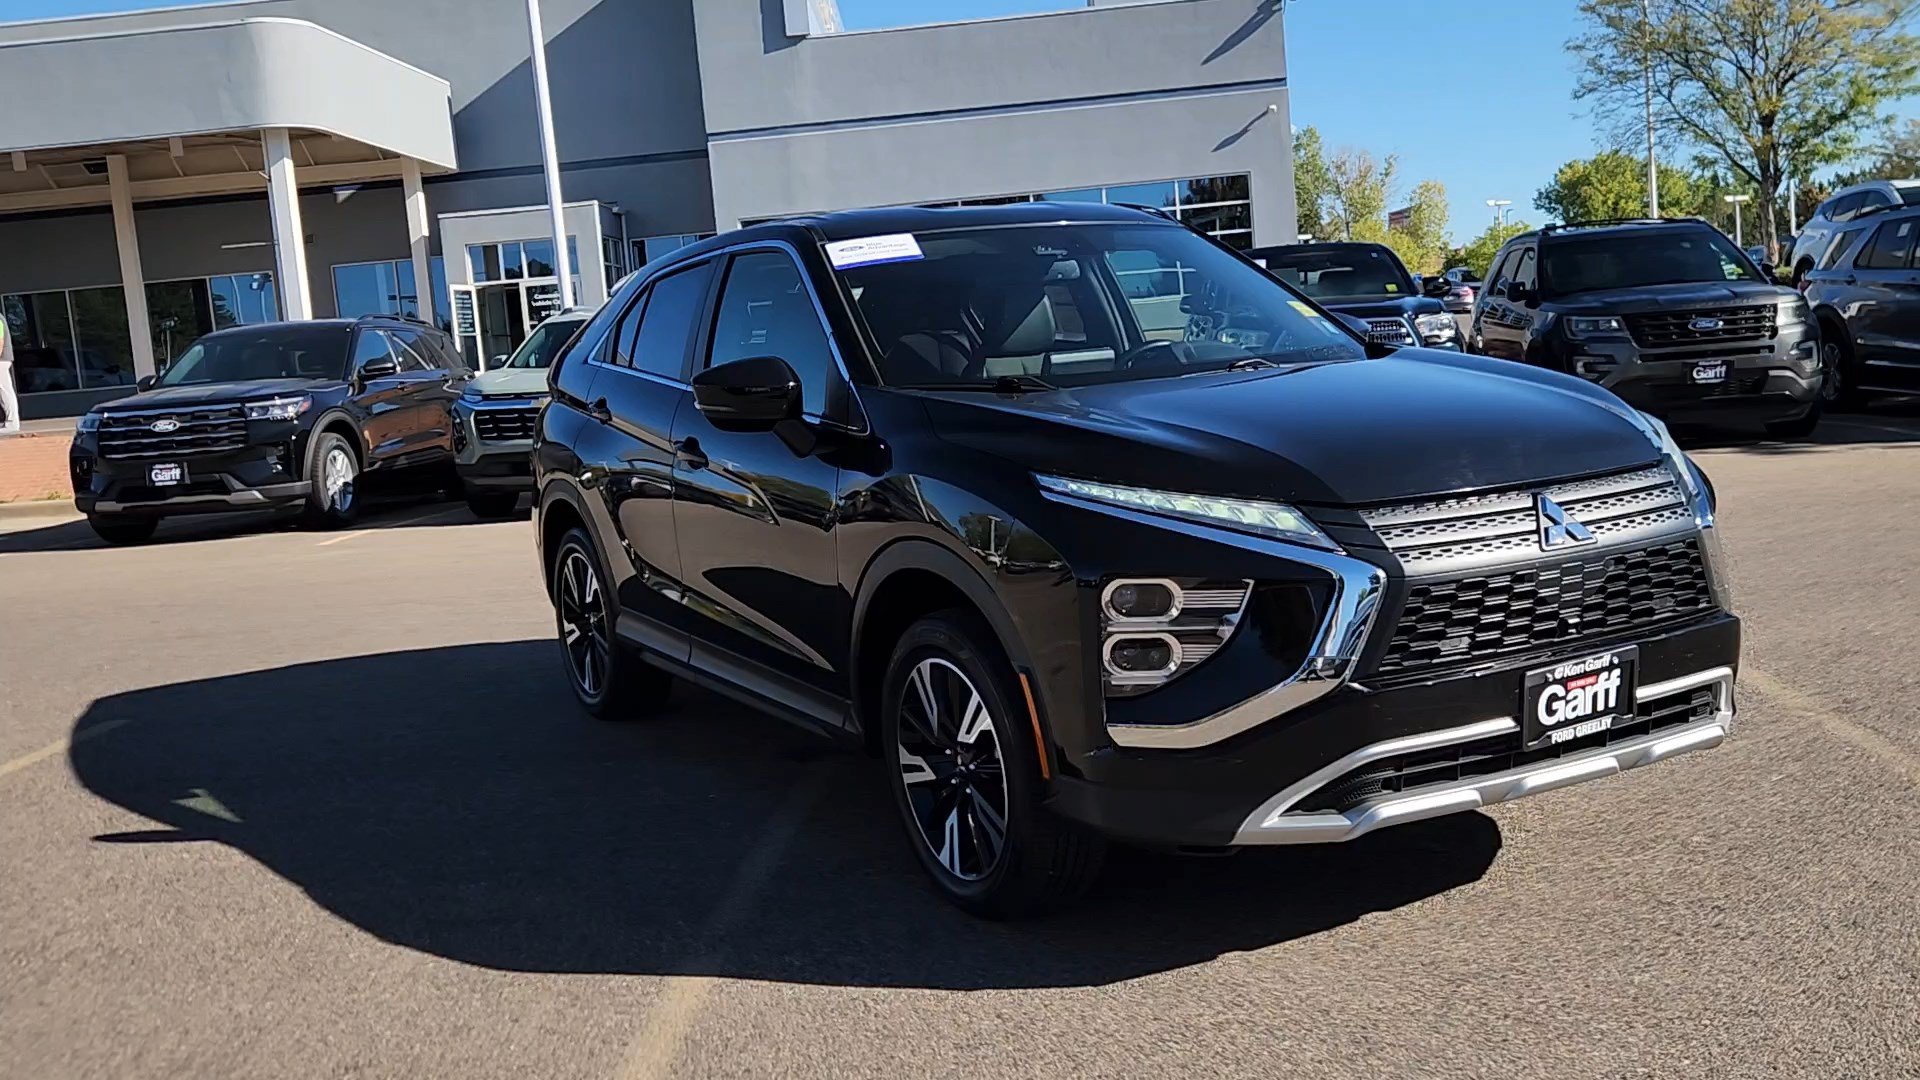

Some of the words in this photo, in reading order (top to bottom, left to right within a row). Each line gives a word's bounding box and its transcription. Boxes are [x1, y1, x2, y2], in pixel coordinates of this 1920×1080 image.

[1692, 365, 1727, 379] Garff
[151, 468, 181, 481] Garff
[1564, 664, 1584, 675] Ken
[1585, 654, 1612, 670] Garff
[1537, 668, 1621, 726] Garff
[1551, 730, 1574, 744] FORD
[1576, 718, 1612, 737] GREELEY
